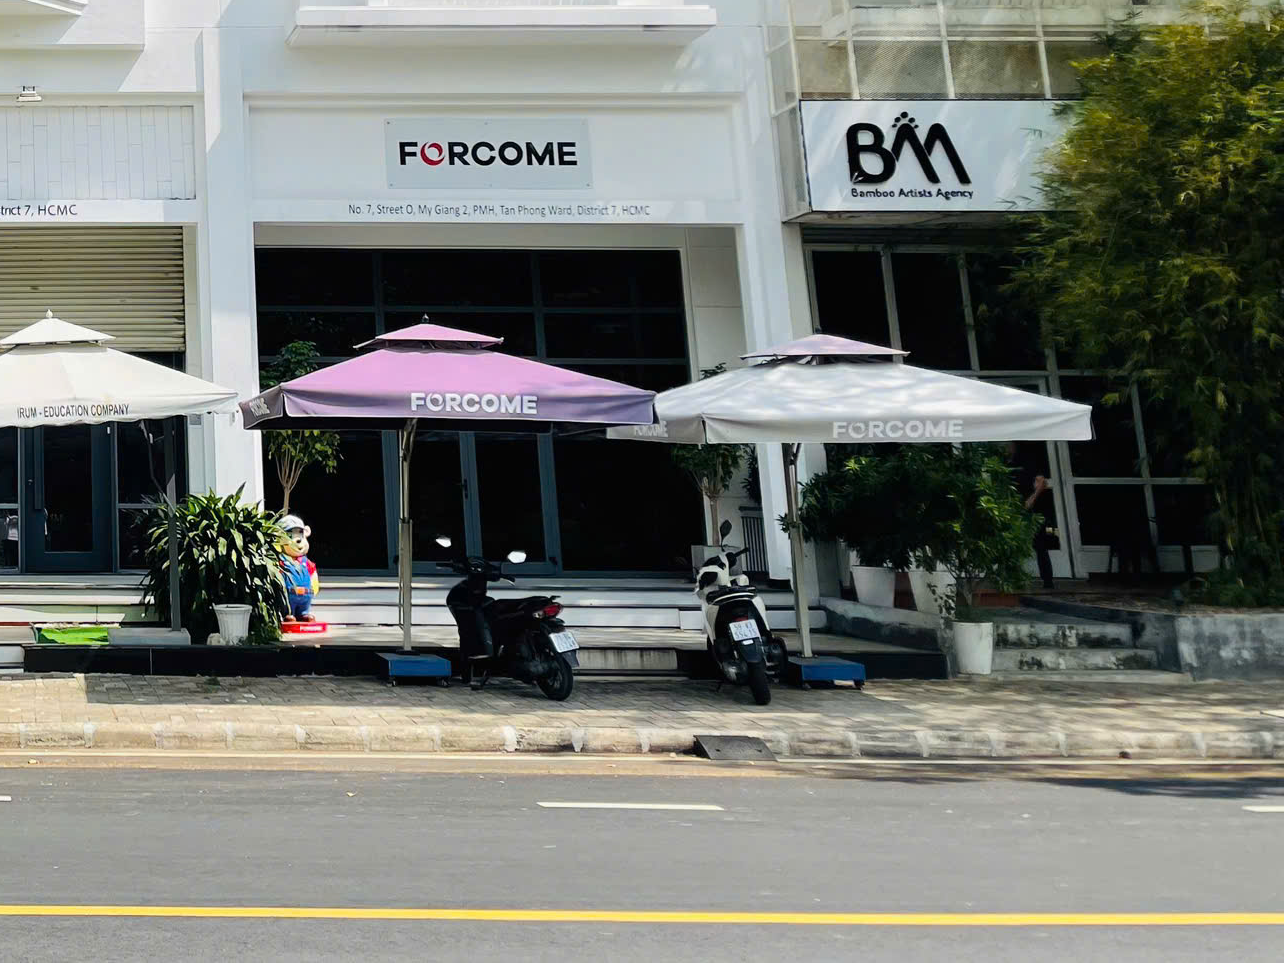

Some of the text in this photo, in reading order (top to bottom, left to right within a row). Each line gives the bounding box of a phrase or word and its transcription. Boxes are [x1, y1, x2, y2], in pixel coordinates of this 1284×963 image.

[398, 141, 578, 166] FORCOME
[851, 188, 974, 200] Bamboo Artists Agency
[38, 204, 78, 216] HCMC
[348, 204, 364, 215] No.
[366, 204, 375, 216] 7,
[377, 204, 404, 215] Street
[418, 204, 433, 217] My
[434, 204, 460, 218] Giang
[462, 205, 471, 216] 2,
[473, 205, 498, 217] PMH,
[500, 205, 516, 216] Tan
[518, 205, 546, 218] Phong
[547, 205, 576, 217] Ward,
[577, 205, 610, 216] District
[622, 205, 651, 216] HCMC
[17, 406, 37, 419] IRUM
[43, 404, 89, 418] EDUCATION
[90, 403, 130, 417] COMPANY
[410, 392, 538, 414] FORCOME
[832, 419, 963, 439] FORCOME
